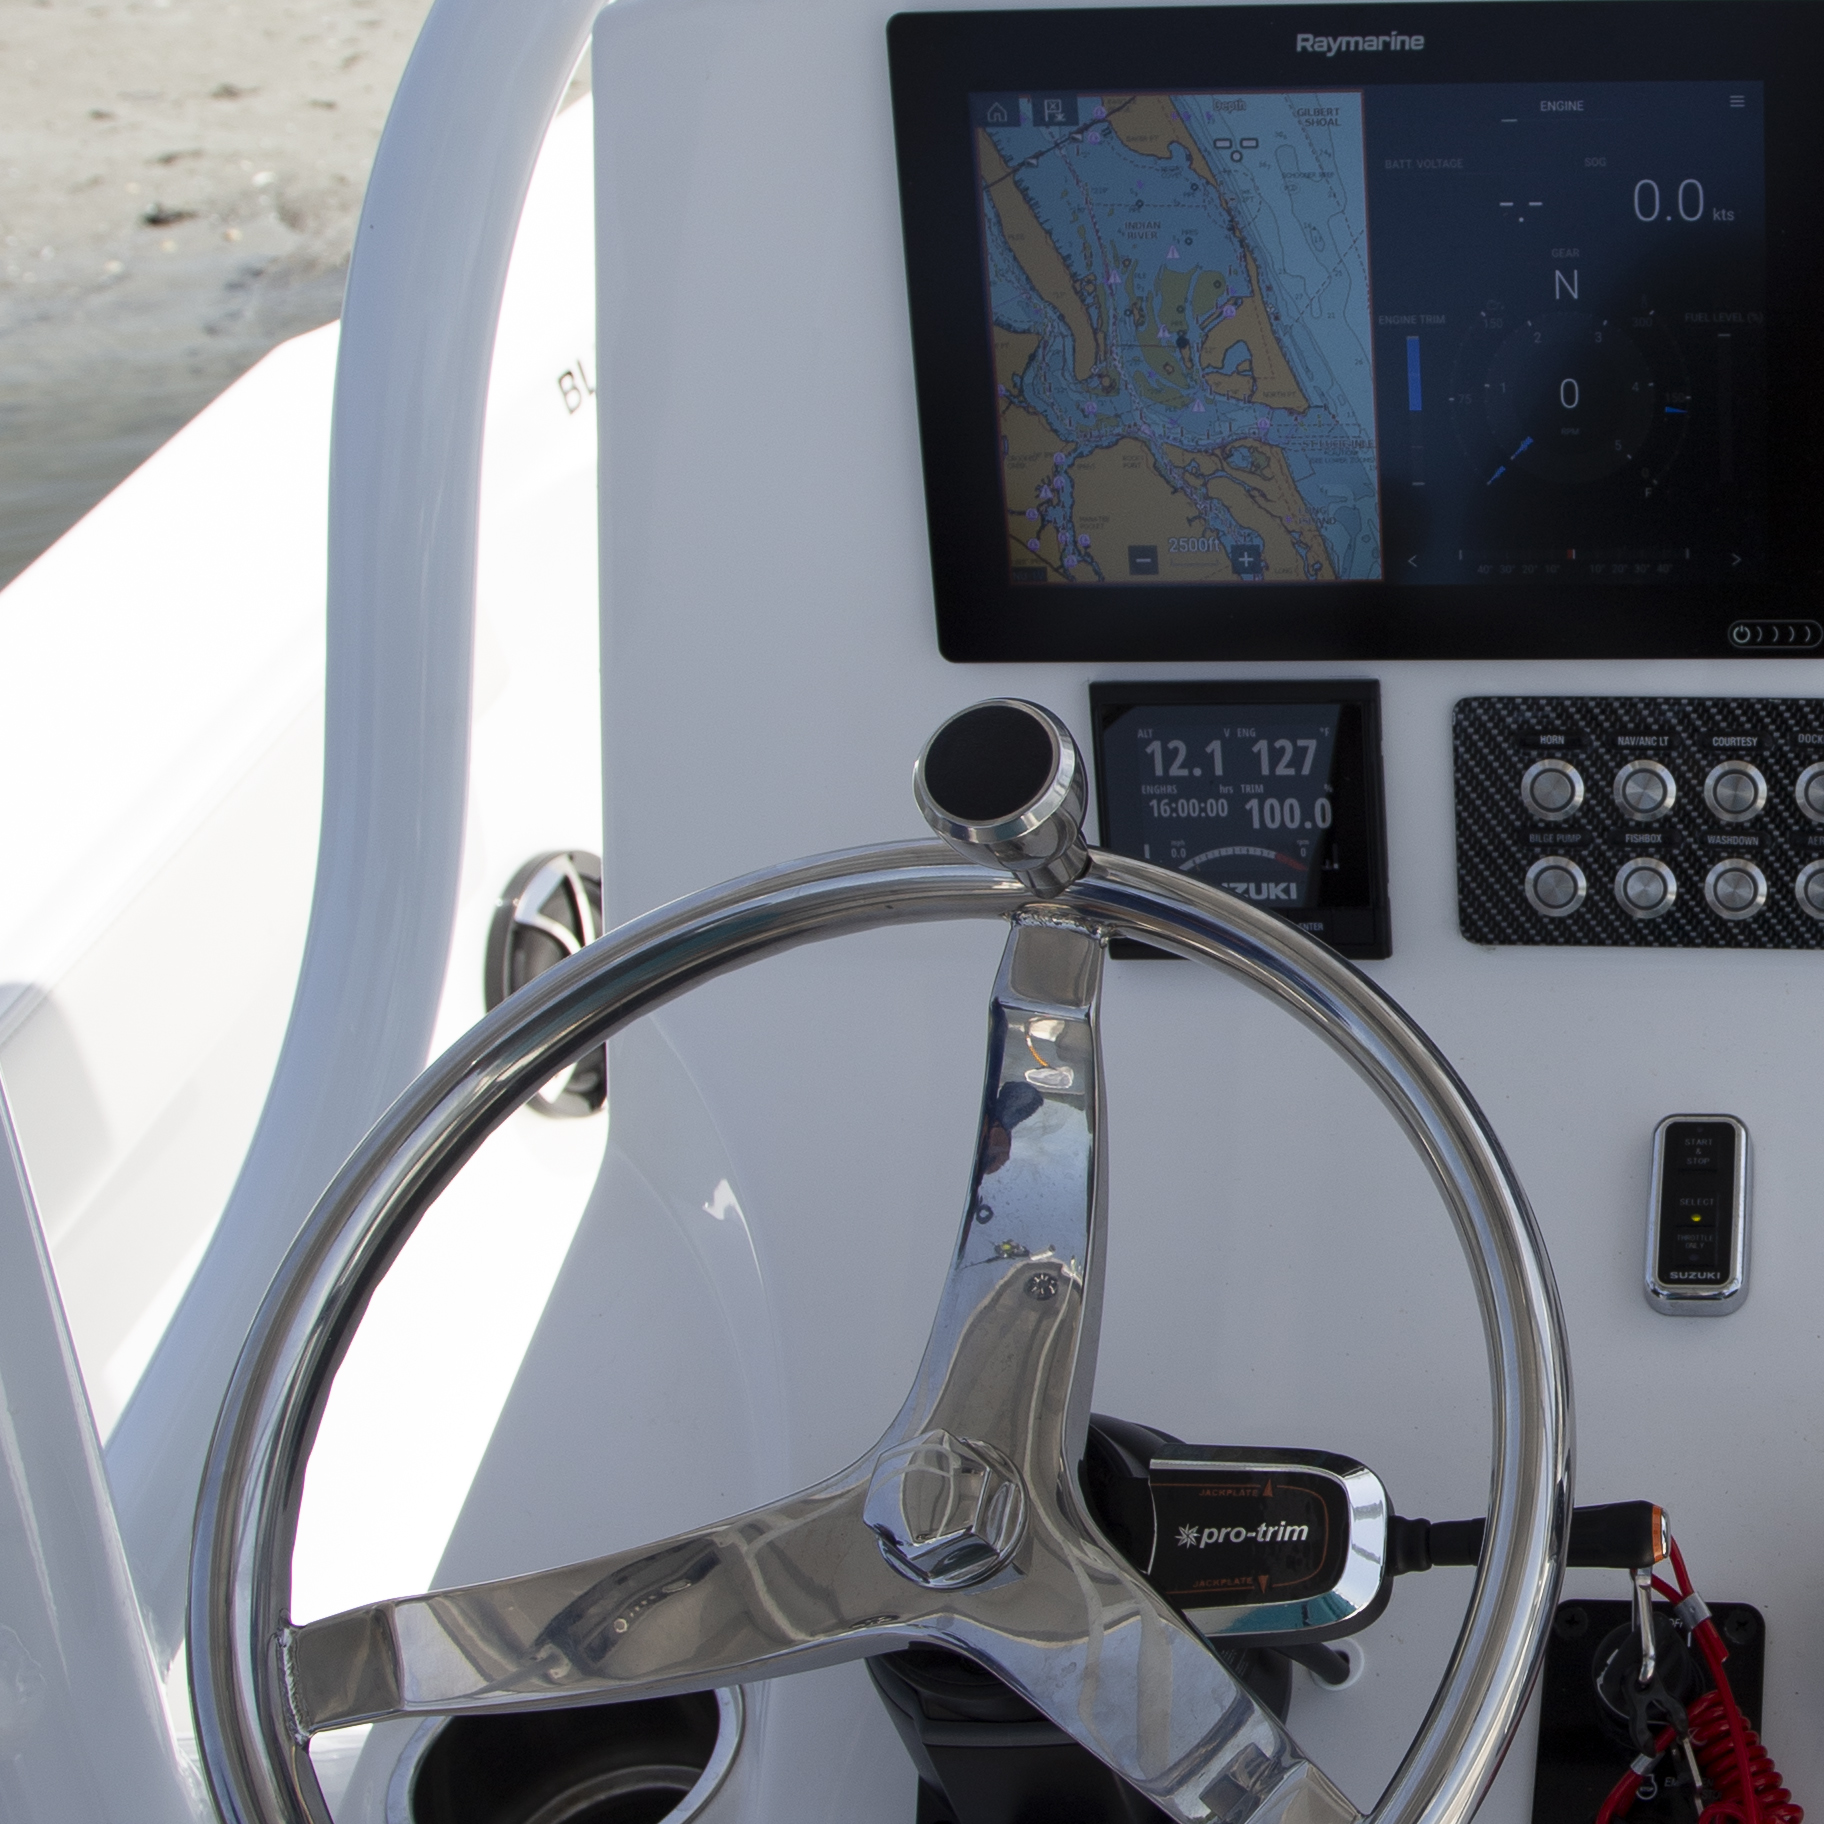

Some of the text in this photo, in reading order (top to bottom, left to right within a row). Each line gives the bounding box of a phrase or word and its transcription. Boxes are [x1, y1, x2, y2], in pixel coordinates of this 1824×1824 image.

[1296, 30, 1425, 57] Raymarine
[1540, 100, 1585, 112] ENGINE
[1384, 158, 1464, 170] BATT VOLTAGE
[1584, 157, 1607, 168] SOG
[1632, 178, 1735, 223] 0.0 kts
[1551, 248, 1580, 258] GEAR
[1554, 269, 1580, 301] N
[1378, 314, 1446, 325] ENGINE TRIM
[1684, 312, 1710, 323] FUEL
[1712, 312, 1744, 323] LEVEL
[1559, 377, 1580, 409] 0
[1560, 426, 1580, 436] RPM
[1169, 537, 1221, 554] 2500ft
[1137, 728, 1153, 739] ALT
[1223, 727, 1230, 738] V
[1237, 727, 1256, 738] ENG
[1539, 735, 1565, 746] HORN
[1617, 735, 1669, 746] NAV/ANC LT
[1712, 736, 1758, 748] COURTESY
[1145, 739, 1224, 777] 12.1
[1251, 738, 1318, 776] 127
[1141, 784, 1178, 795] ENGHRS
[1219, 783, 1234, 794] hrs
[1240, 784, 1264, 794] TRIM
[1149, 798, 1228, 817] 16:00:00
[1245, 796, 1333, 829] 100.0
[1529, 833, 1582, 844] BILGE PUMP
[1625, 833, 1662, 844] FISHBOX
[1707, 834, 1760, 846] WASHDOWN
[1222, 882, 1298, 900] ZUKI
[1684, 1138, 1713, 1146] START
[1686, 1157, 1711, 1166] STOP
[1679, 1198, 1714, 1207] SELECT
[1677, 1234, 1714, 1242] THROTTLE
[1669, 1271, 1721, 1280] SUZUKI
[1199, 1489, 1258, 1497] JACKPLATE
[1199, 1520, 1310, 1549] pro-trim
[1193, 1576, 1254, 1588] JACKPLATE
